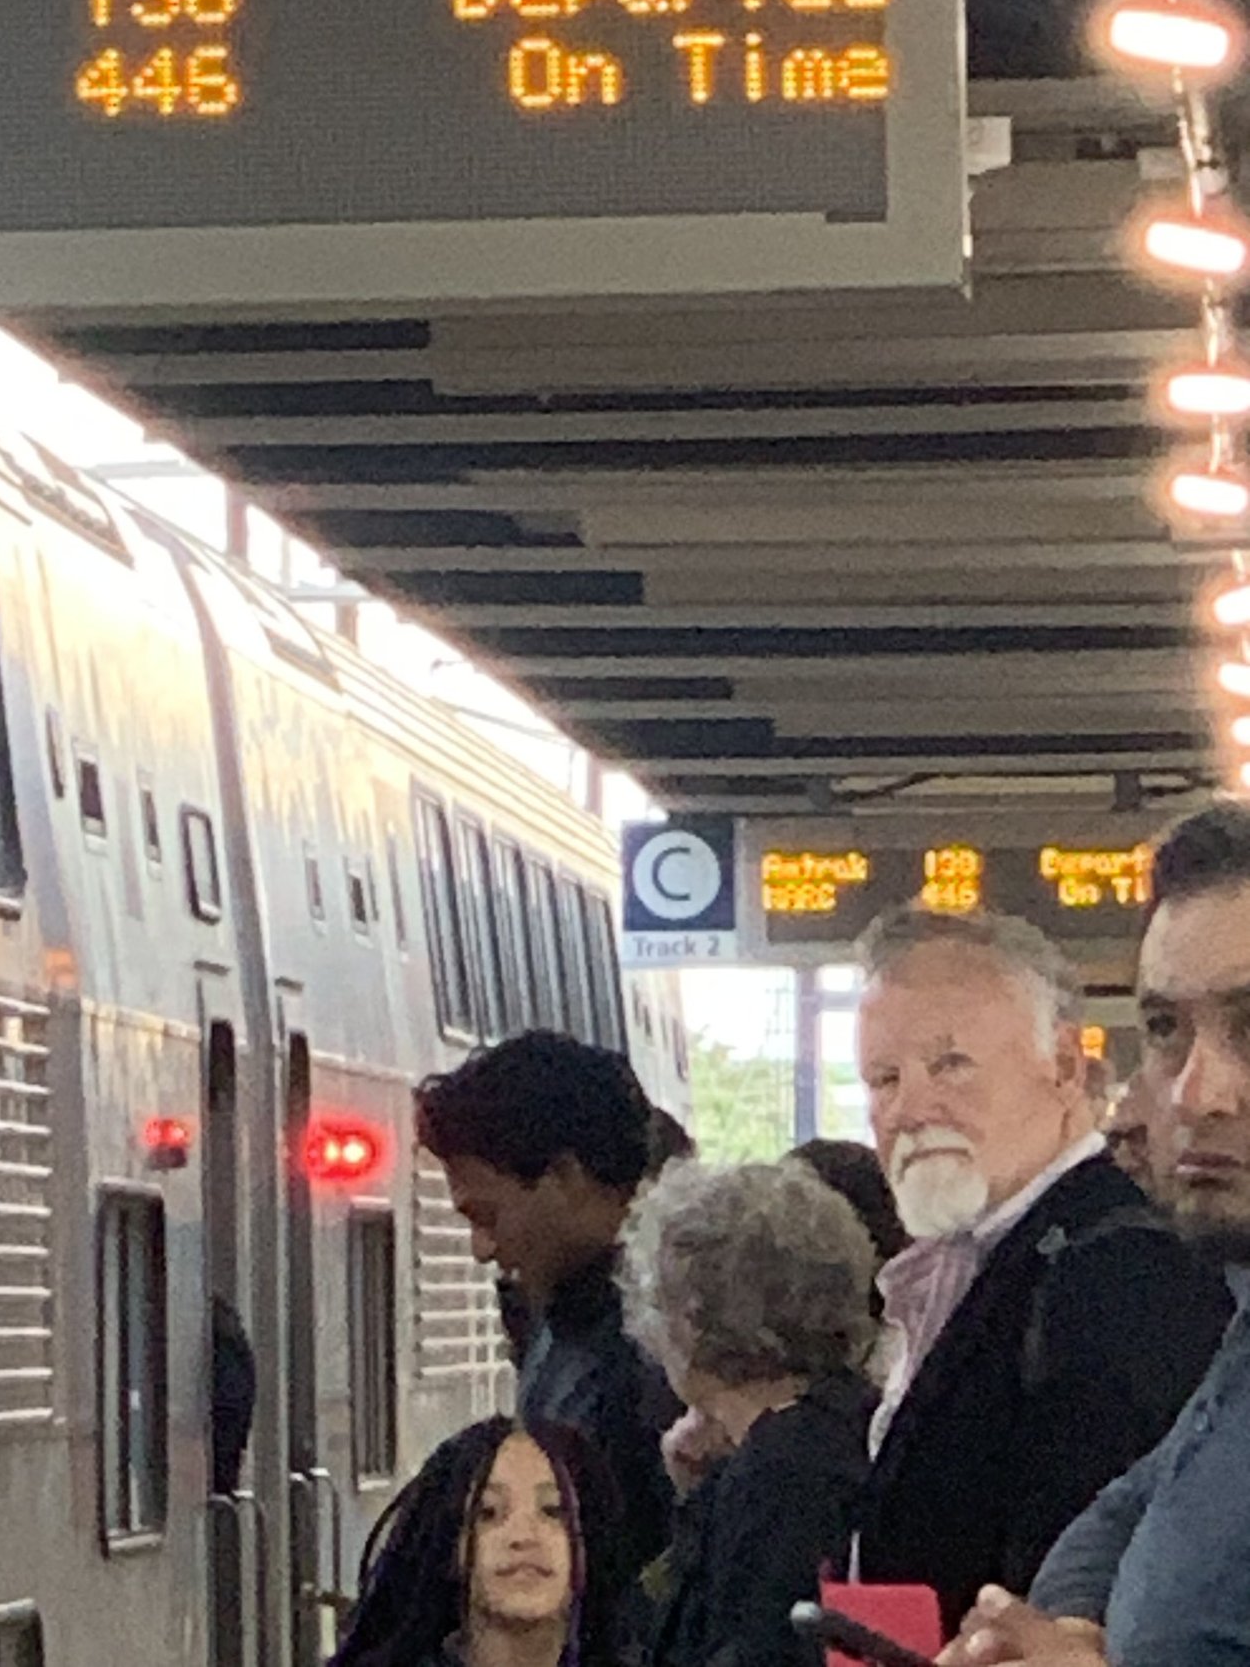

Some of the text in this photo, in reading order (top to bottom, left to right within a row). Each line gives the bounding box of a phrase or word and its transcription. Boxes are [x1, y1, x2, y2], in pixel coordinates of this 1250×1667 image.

[76, 45, 239, 117] 446
[509, 36, 620, 108] On
[672, 32, 889, 104] Time
[652, 847, 691, 901] C
[632, 936, 720, 957] Track 2
